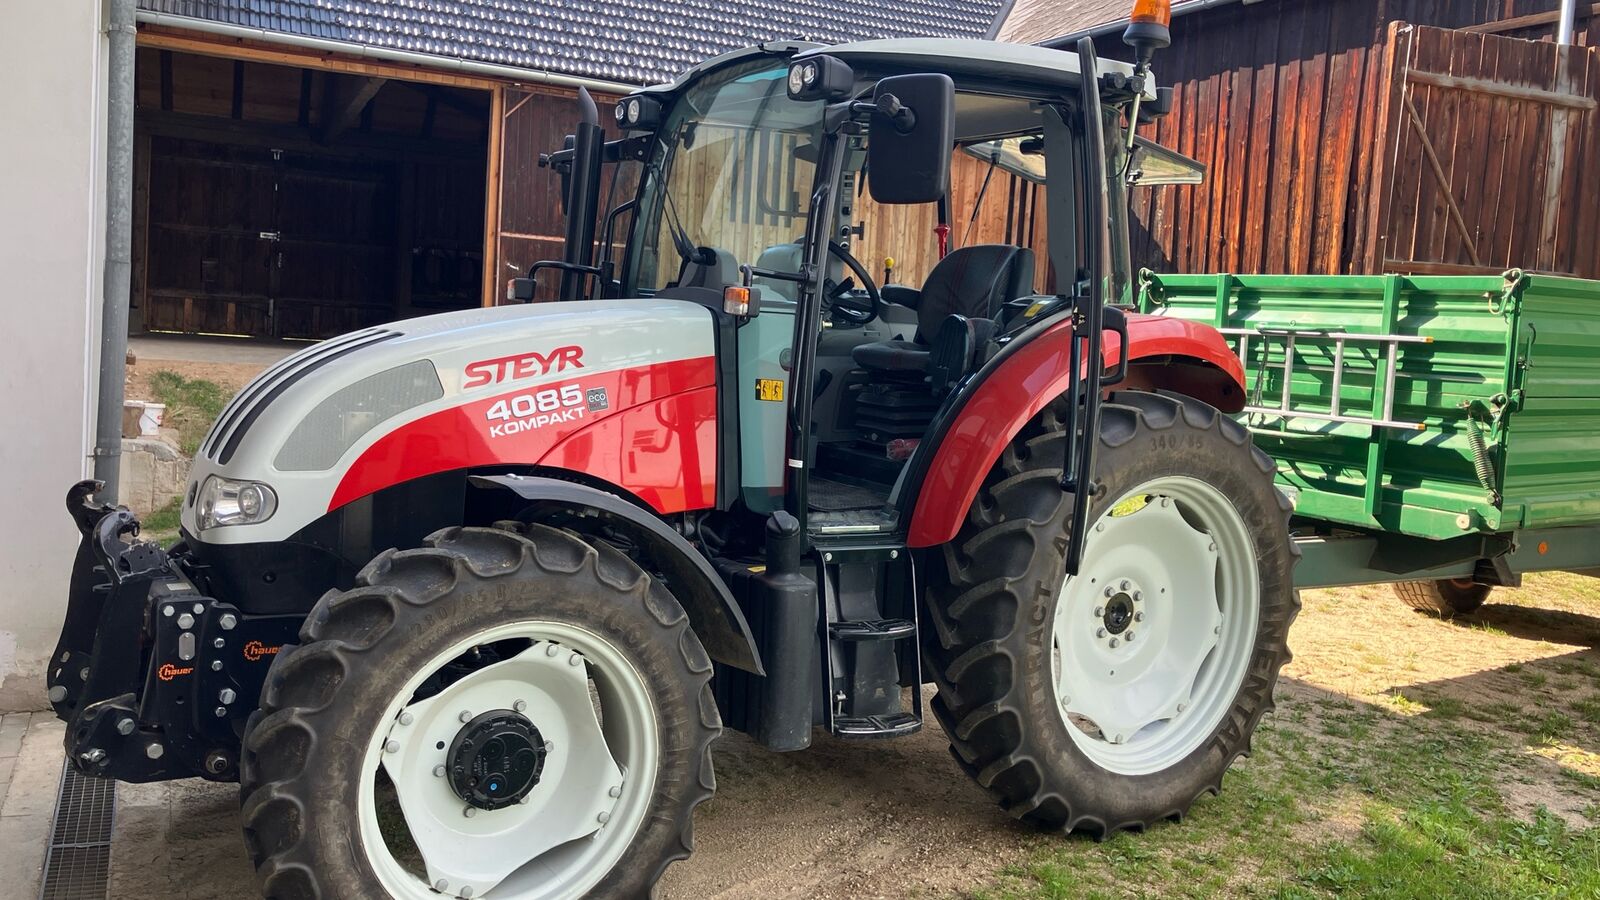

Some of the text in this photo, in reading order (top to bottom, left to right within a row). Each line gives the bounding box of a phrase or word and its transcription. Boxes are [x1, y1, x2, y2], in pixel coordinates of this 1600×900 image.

[463, 345, 585, 389] STEYR
[486, 384, 584, 421] 4085
[588, 394, 606, 403] eco
[490, 406, 586, 438] KOMPAKT
[250, 645, 283, 655] haue
[164, 667, 194, 676] hauer
